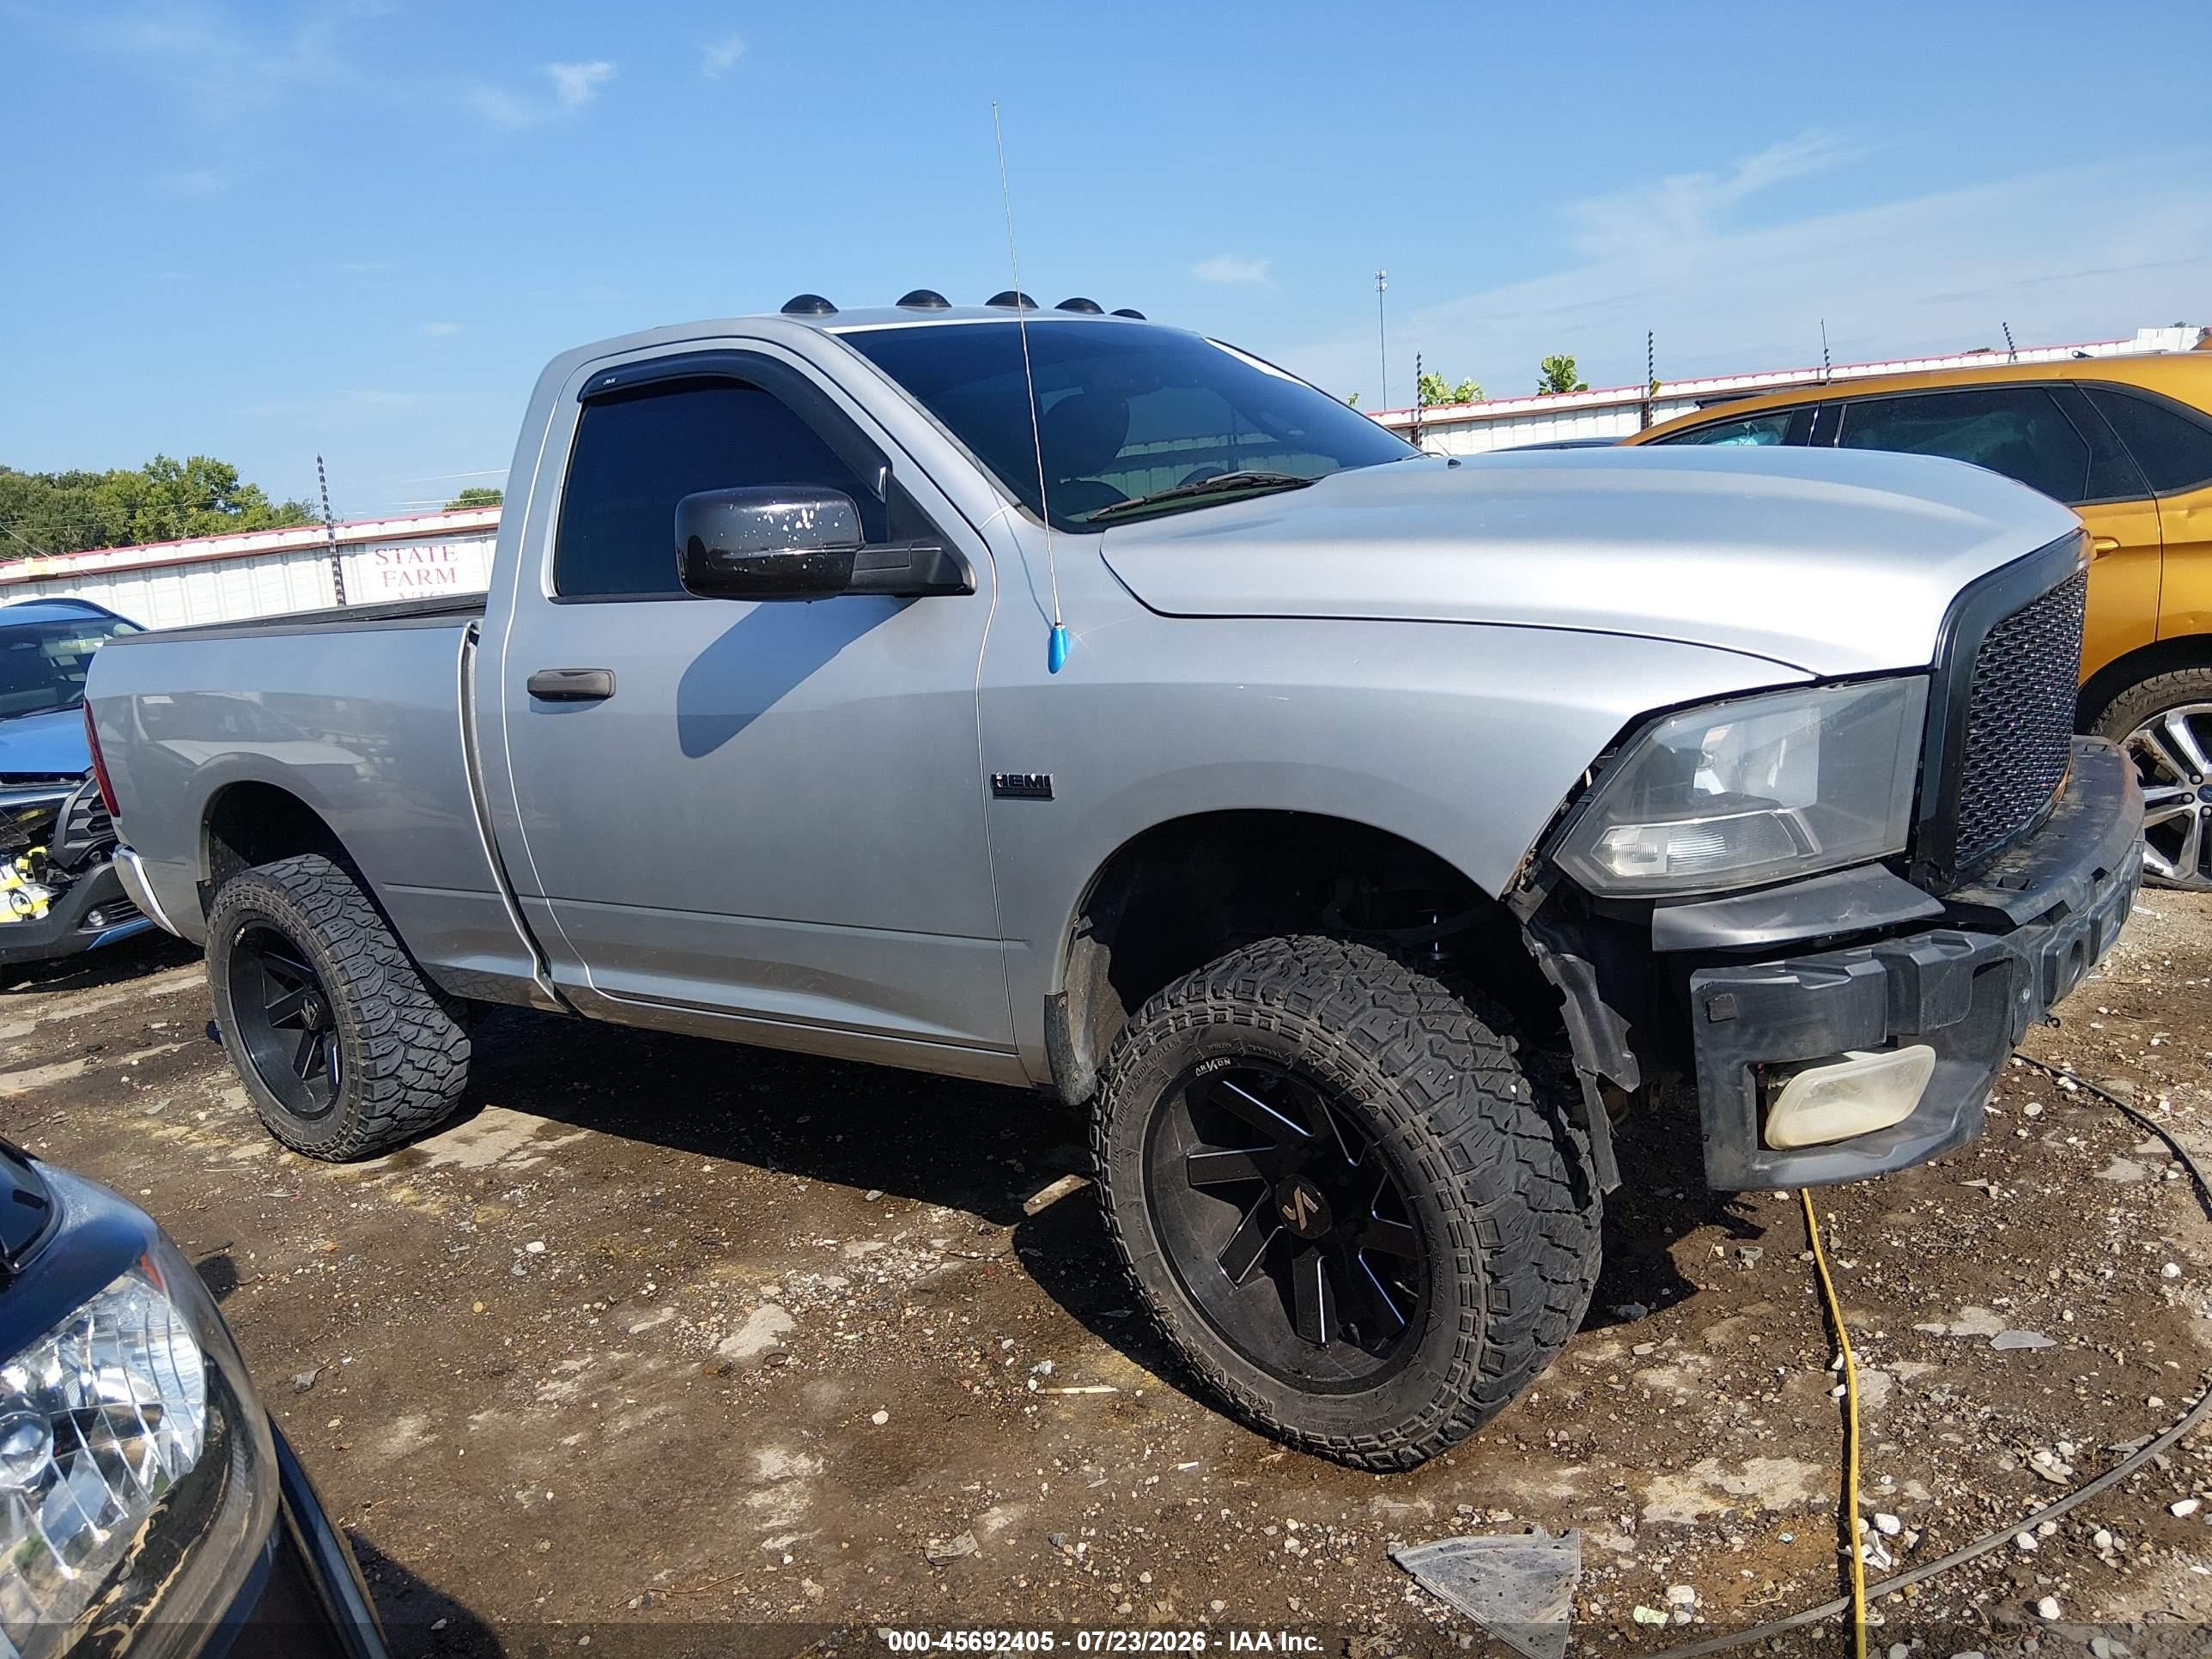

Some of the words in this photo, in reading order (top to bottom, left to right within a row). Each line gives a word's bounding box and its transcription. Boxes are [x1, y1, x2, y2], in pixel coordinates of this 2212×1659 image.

[374, 544, 458, 565] STATE
[382, 567, 456, 587] FARM
[990, 772, 1054, 791] HEMI
[1300, 1048, 1382, 1120] KENDA
